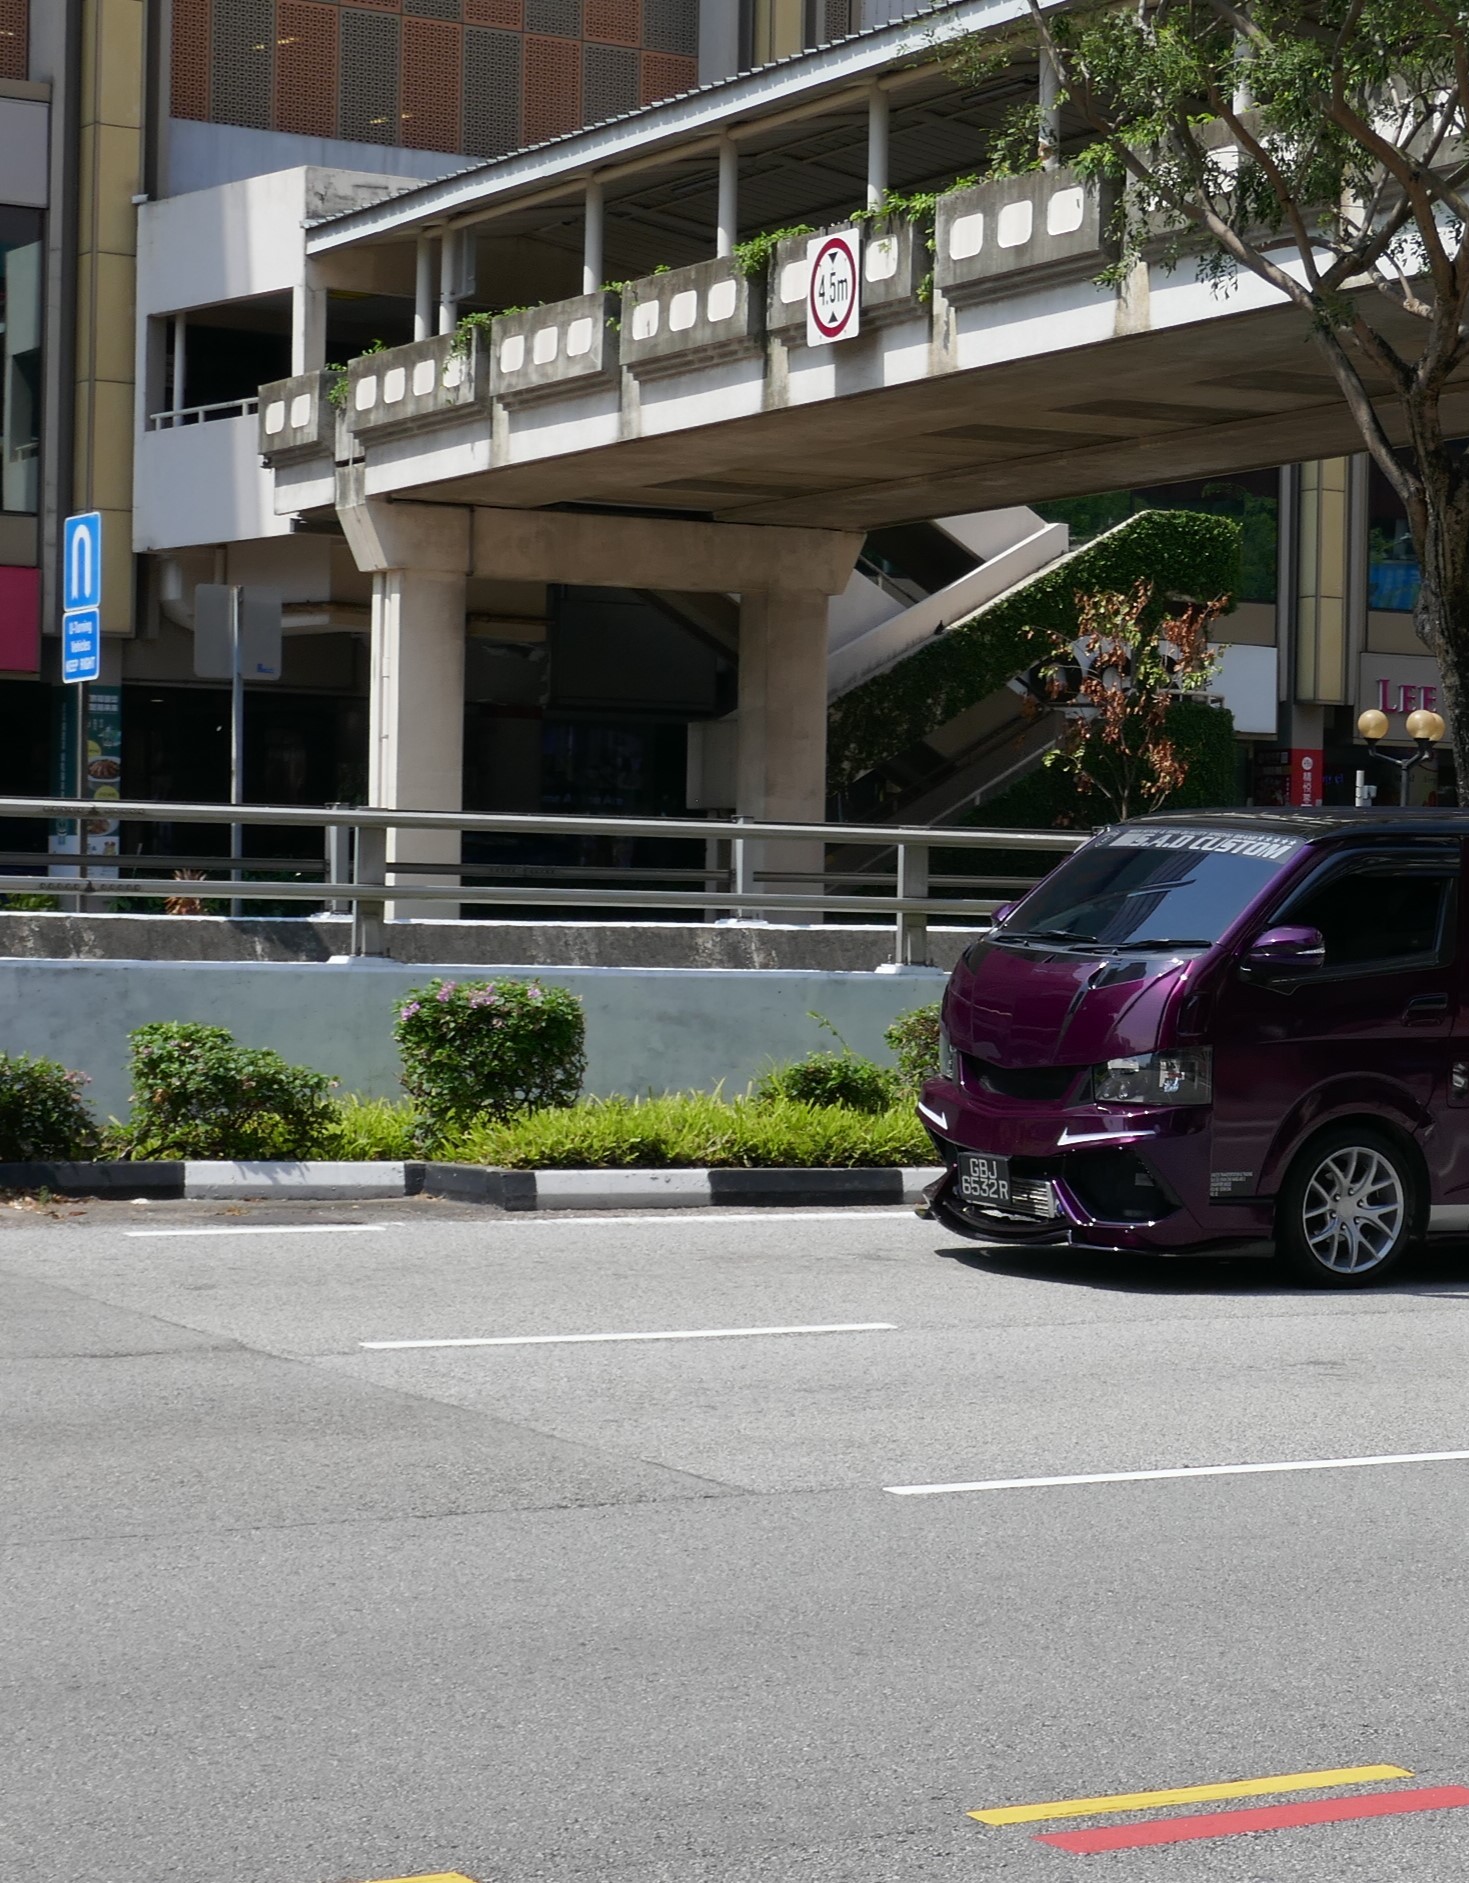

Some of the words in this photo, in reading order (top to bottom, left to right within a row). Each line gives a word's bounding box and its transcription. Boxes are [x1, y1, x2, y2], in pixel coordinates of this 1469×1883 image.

[818, 272, 848, 306] 4.5m
[1378, 679, 1437, 714] LEE
[1188, 836, 1292, 860] CUSTOM
[969, 1158, 998, 1179] GBJ
[961, 1175, 1009, 1200] 6532R
